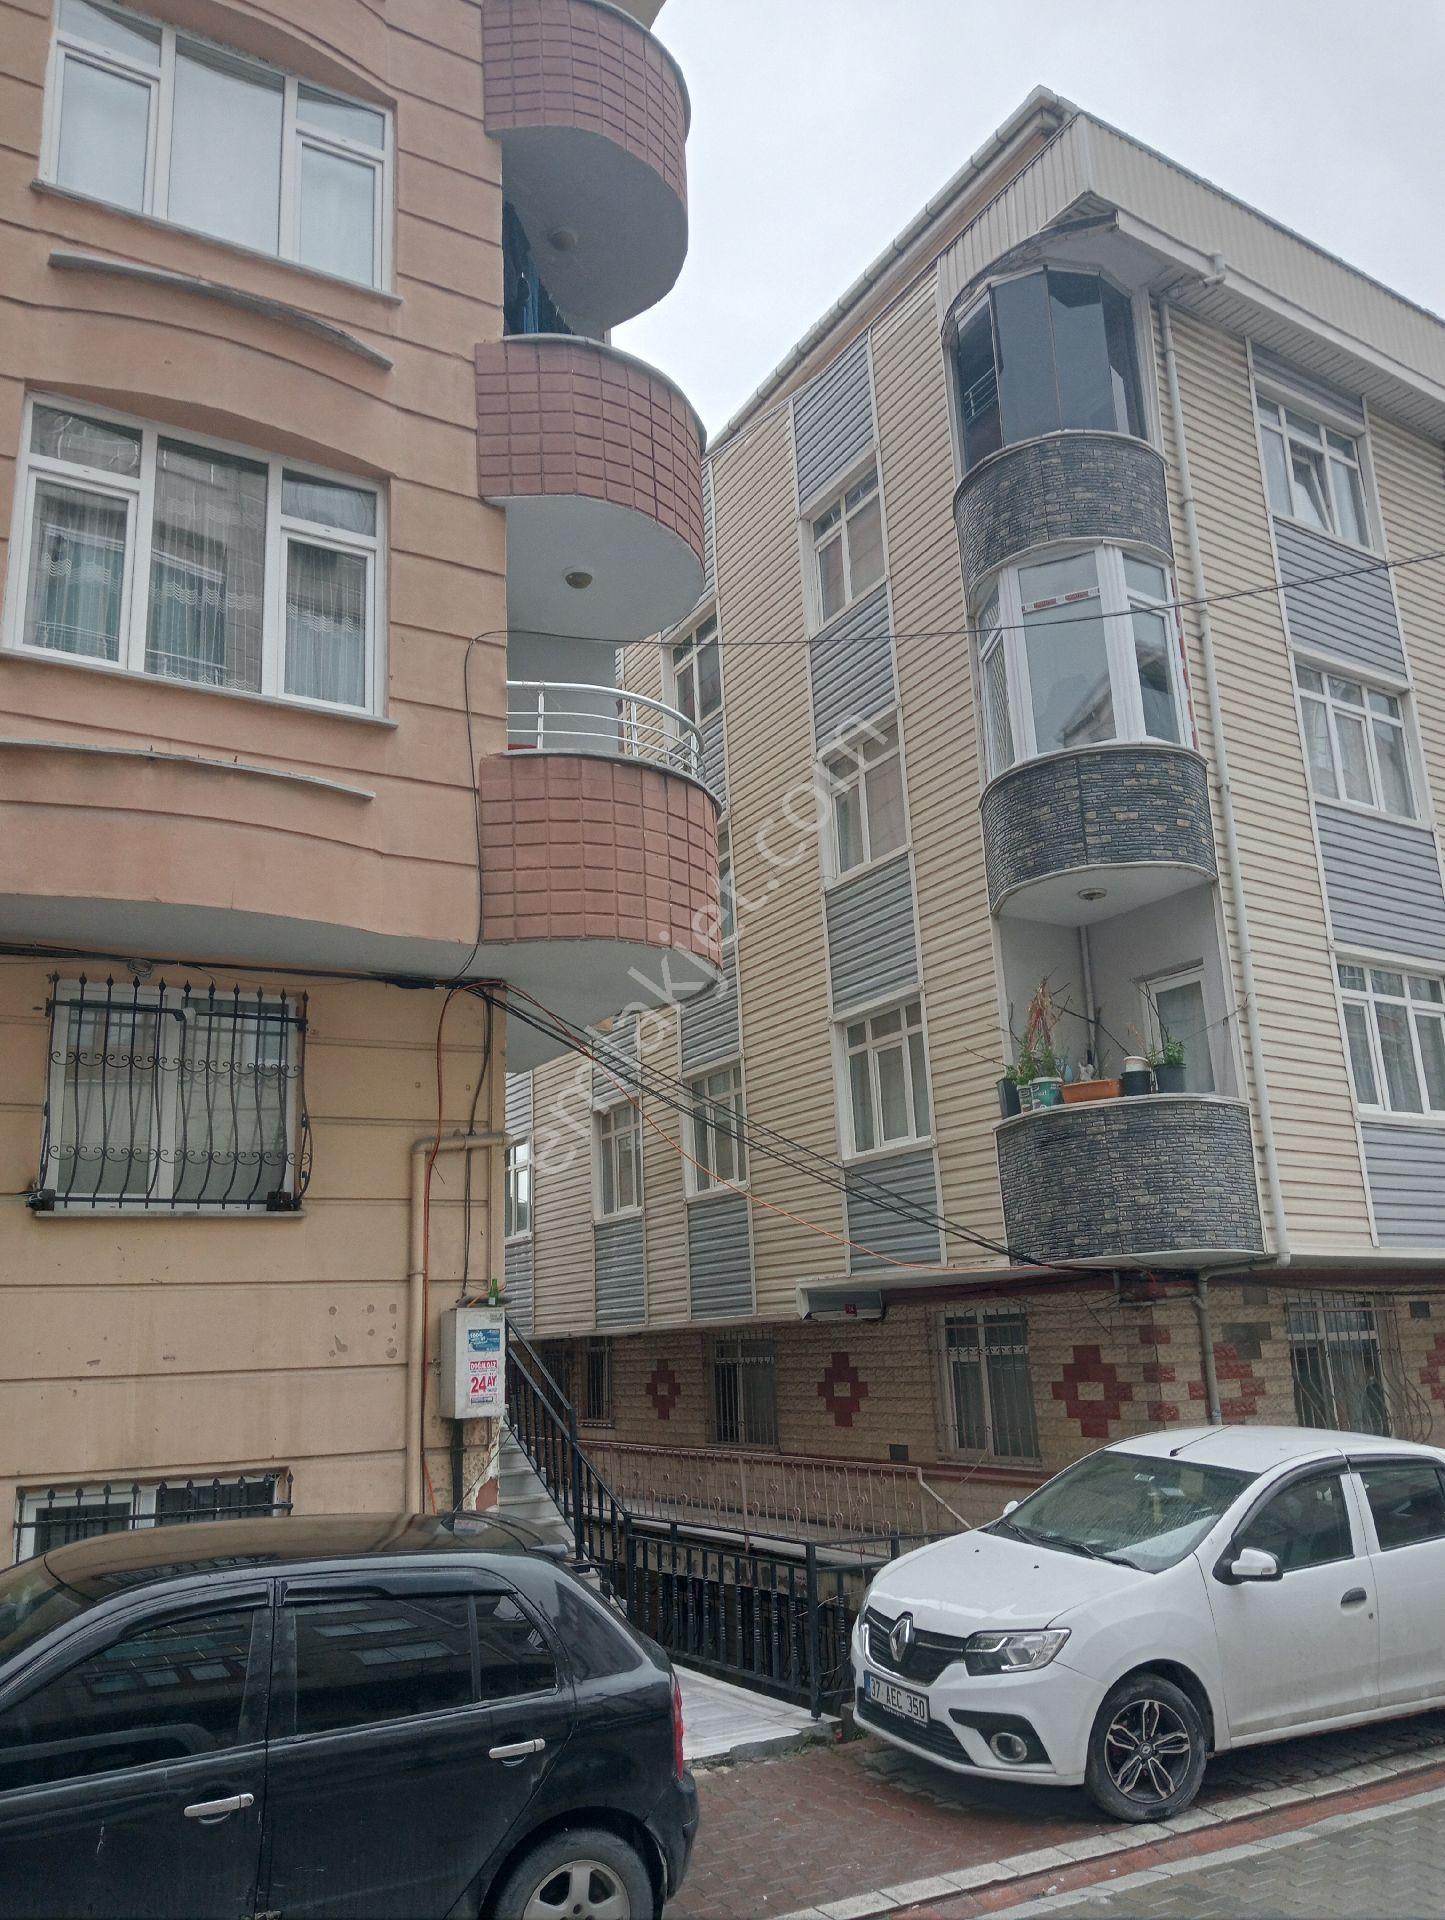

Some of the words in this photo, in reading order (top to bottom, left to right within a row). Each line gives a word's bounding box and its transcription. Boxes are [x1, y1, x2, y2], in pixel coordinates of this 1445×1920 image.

[471, 1376, 487, 1393] 24
[487, 1376, 497, 1387] AY
[872, 1679, 880, 1698] 37
[887, 1686, 902, 1708] AEC
[907, 1695, 924, 1718] 350
